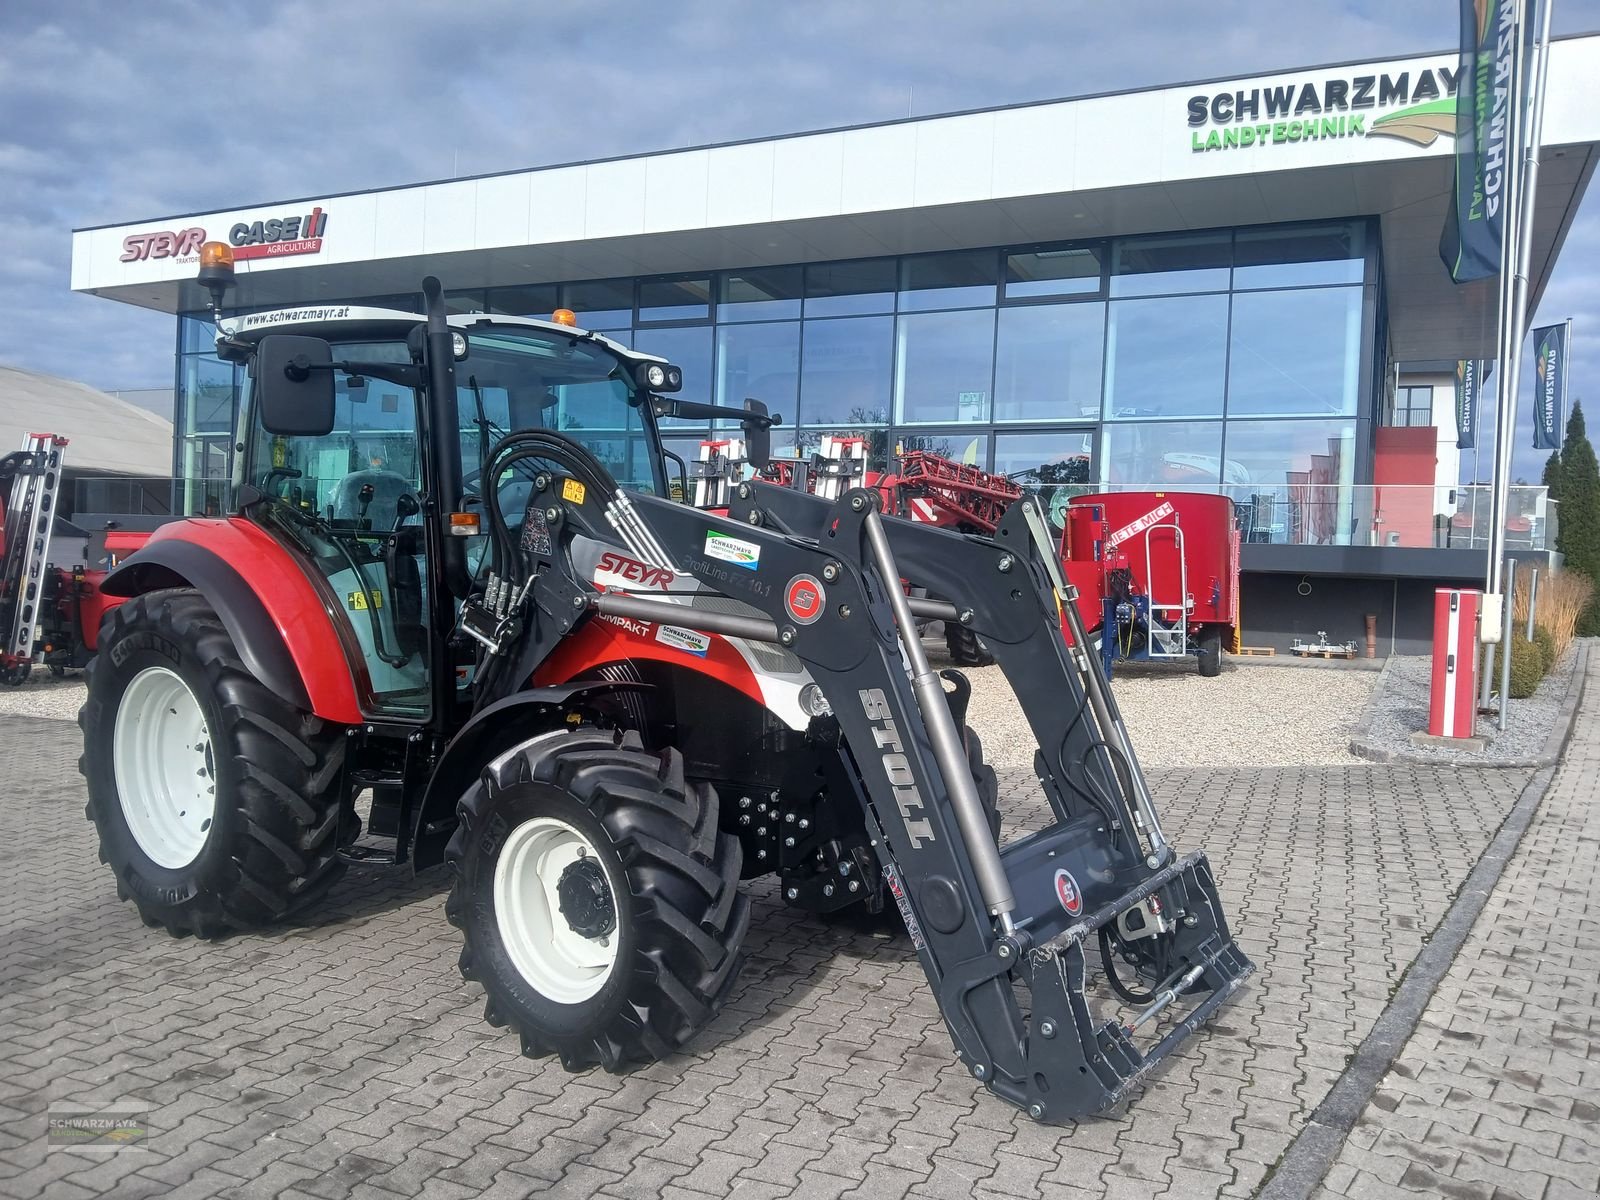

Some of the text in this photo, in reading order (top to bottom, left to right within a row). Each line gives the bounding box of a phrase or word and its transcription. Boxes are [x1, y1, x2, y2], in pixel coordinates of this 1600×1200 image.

[1187, 66, 1465, 125] SCHWARZMAY
[1192, 114, 1367, 151] LANDTECHNIK
[119, 227, 206, 262] STEYR
[229, 216, 302, 246] CASE
[267, 242, 317, 254] AGRICULTURE
[246, 306, 350, 326] www.schwarzmayr.at
[1140, 503, 1173, 527] MICH
[596, 552, 674, 591] STEYR
[597, 611, 650, 637] OMPAKT
[662, 625, 702, 643] SCHWARZMAYR
[858, 688, 936, 849] STOLL
